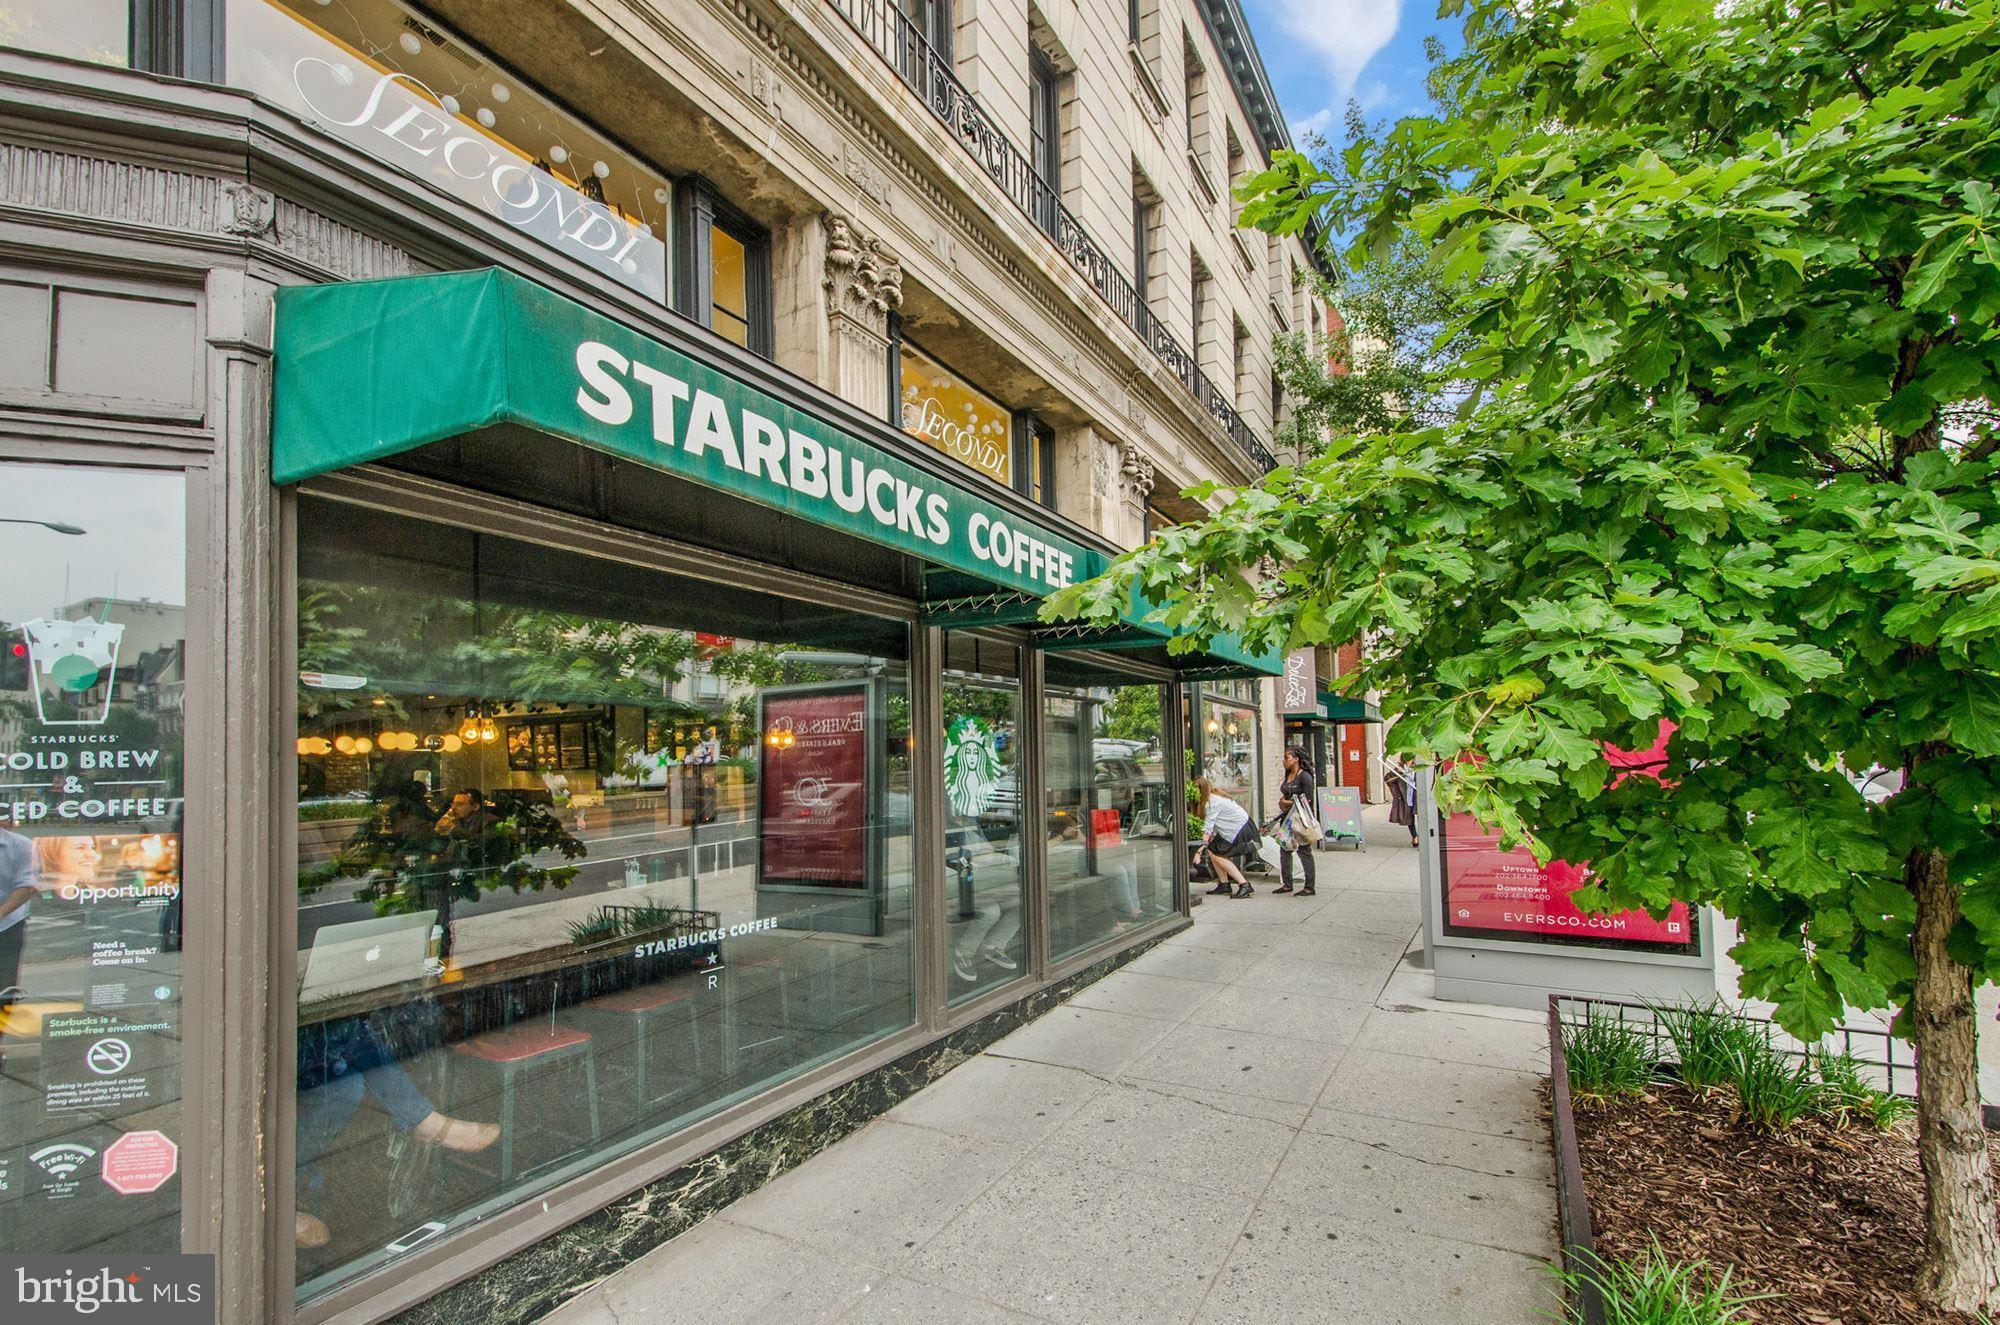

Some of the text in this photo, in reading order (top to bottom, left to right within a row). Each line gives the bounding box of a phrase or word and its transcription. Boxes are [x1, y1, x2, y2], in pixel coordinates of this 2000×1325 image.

[576, 341, 1072, 589] STARBUCKS COFFEE
[79, 750, 159, 769] BREW
[63, 775, 84, 793] &
[58, 798, 166, 818] COFFEE
[60, 881, 180, 904] Opportunity
[1503, 912, 1626, 930] EVERSCO.COM
[92, 941, 118, 949] Need
[634, 917, 778, 958] STARBUCKS COFFEE
[92, 947, 157, 958] coffee break?
[92, 957, 120, 966] Come
[135, 956, 148, 964] in.
[708, 975, 718, 989] R
[49, 1017, 98, 1027] Starbucks
[49, 1022, 171, 1037] smoke-free environment.
[39, 1155, 63, 1168] Free
